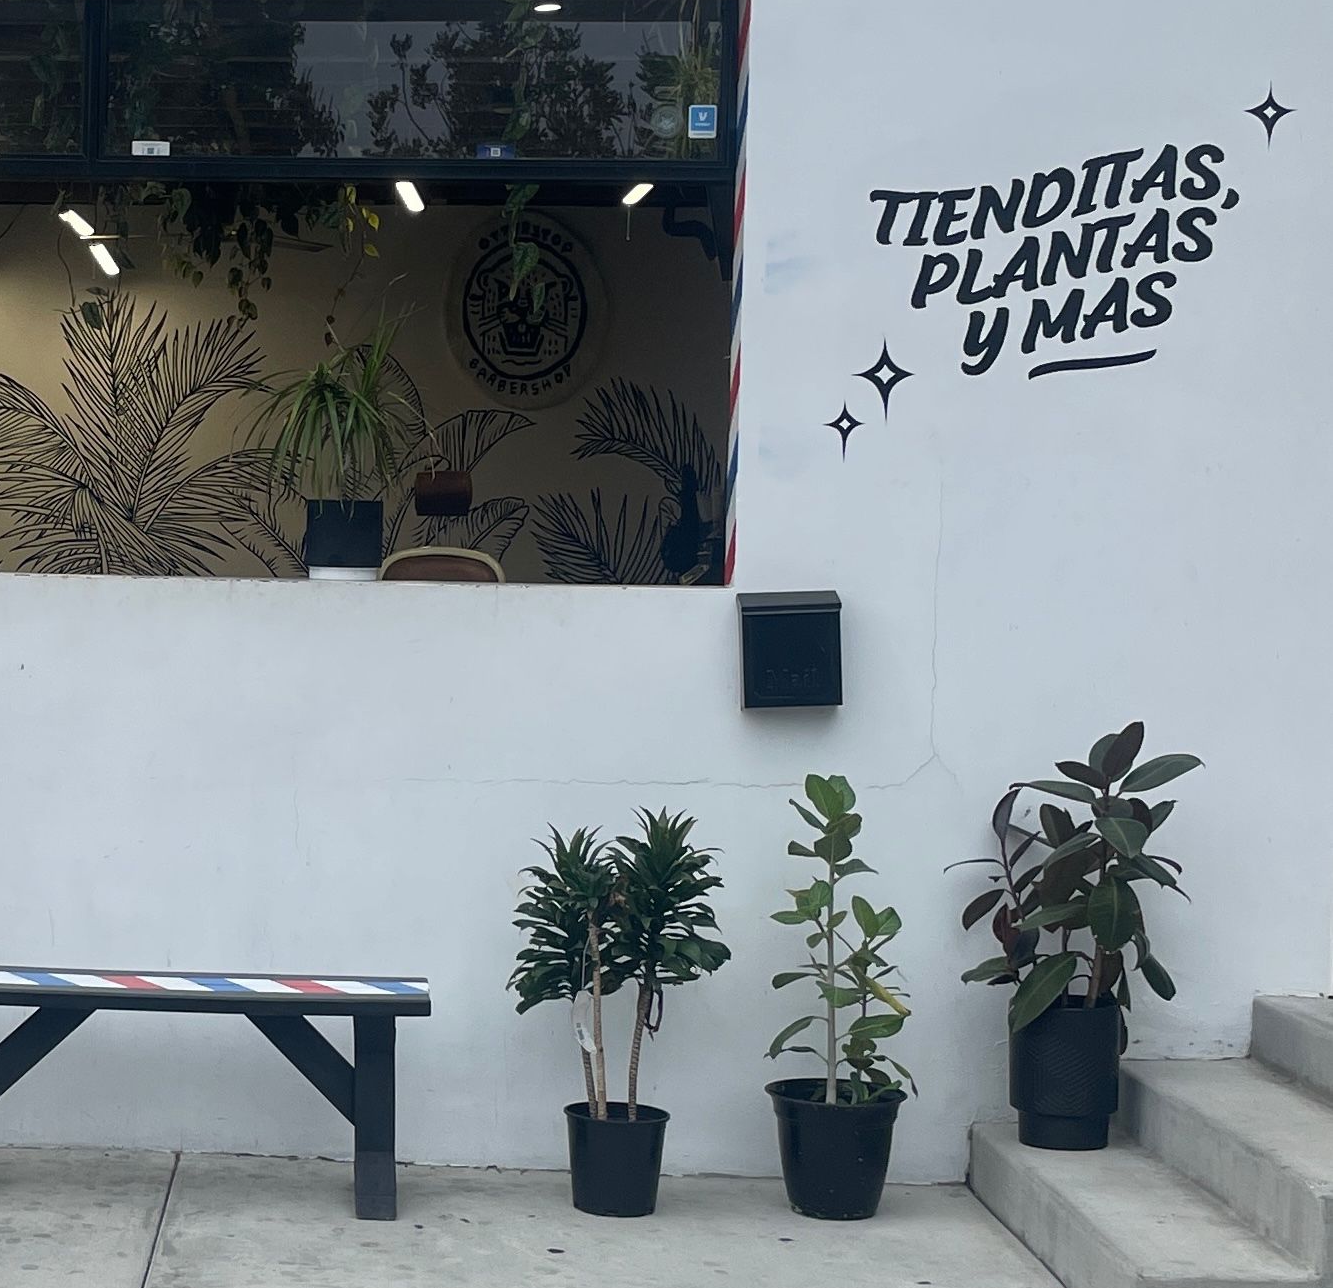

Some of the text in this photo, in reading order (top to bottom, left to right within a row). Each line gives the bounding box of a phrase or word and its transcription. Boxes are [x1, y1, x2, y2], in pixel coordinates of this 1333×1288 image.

[870, 143, 1240, 247] TIENDITAS,
[911, 206, 1217, 310] PLANTAS
[1021, 271, 1177, 355] MAS
[469, 358, 571, 396] BARBERSHOP
